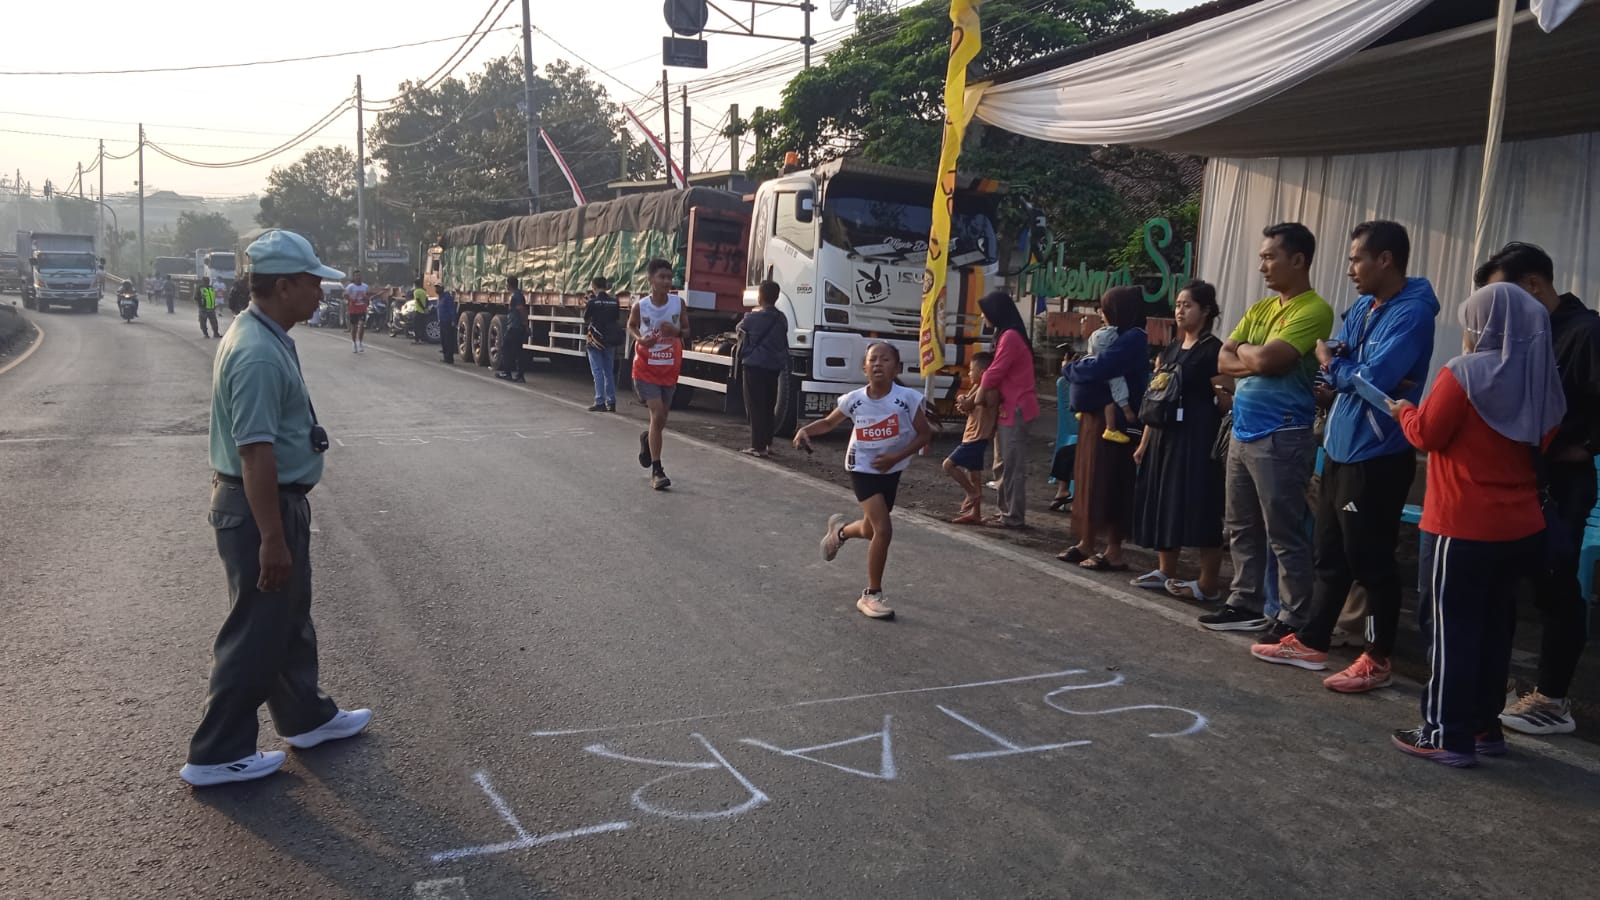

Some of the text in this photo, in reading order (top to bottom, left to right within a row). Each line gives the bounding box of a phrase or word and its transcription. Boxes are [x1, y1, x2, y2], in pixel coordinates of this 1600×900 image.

[897, 271, 924, 284] ISU
[862, 427, 893, 438] F6016
[431, 672, 1210, 863] START
